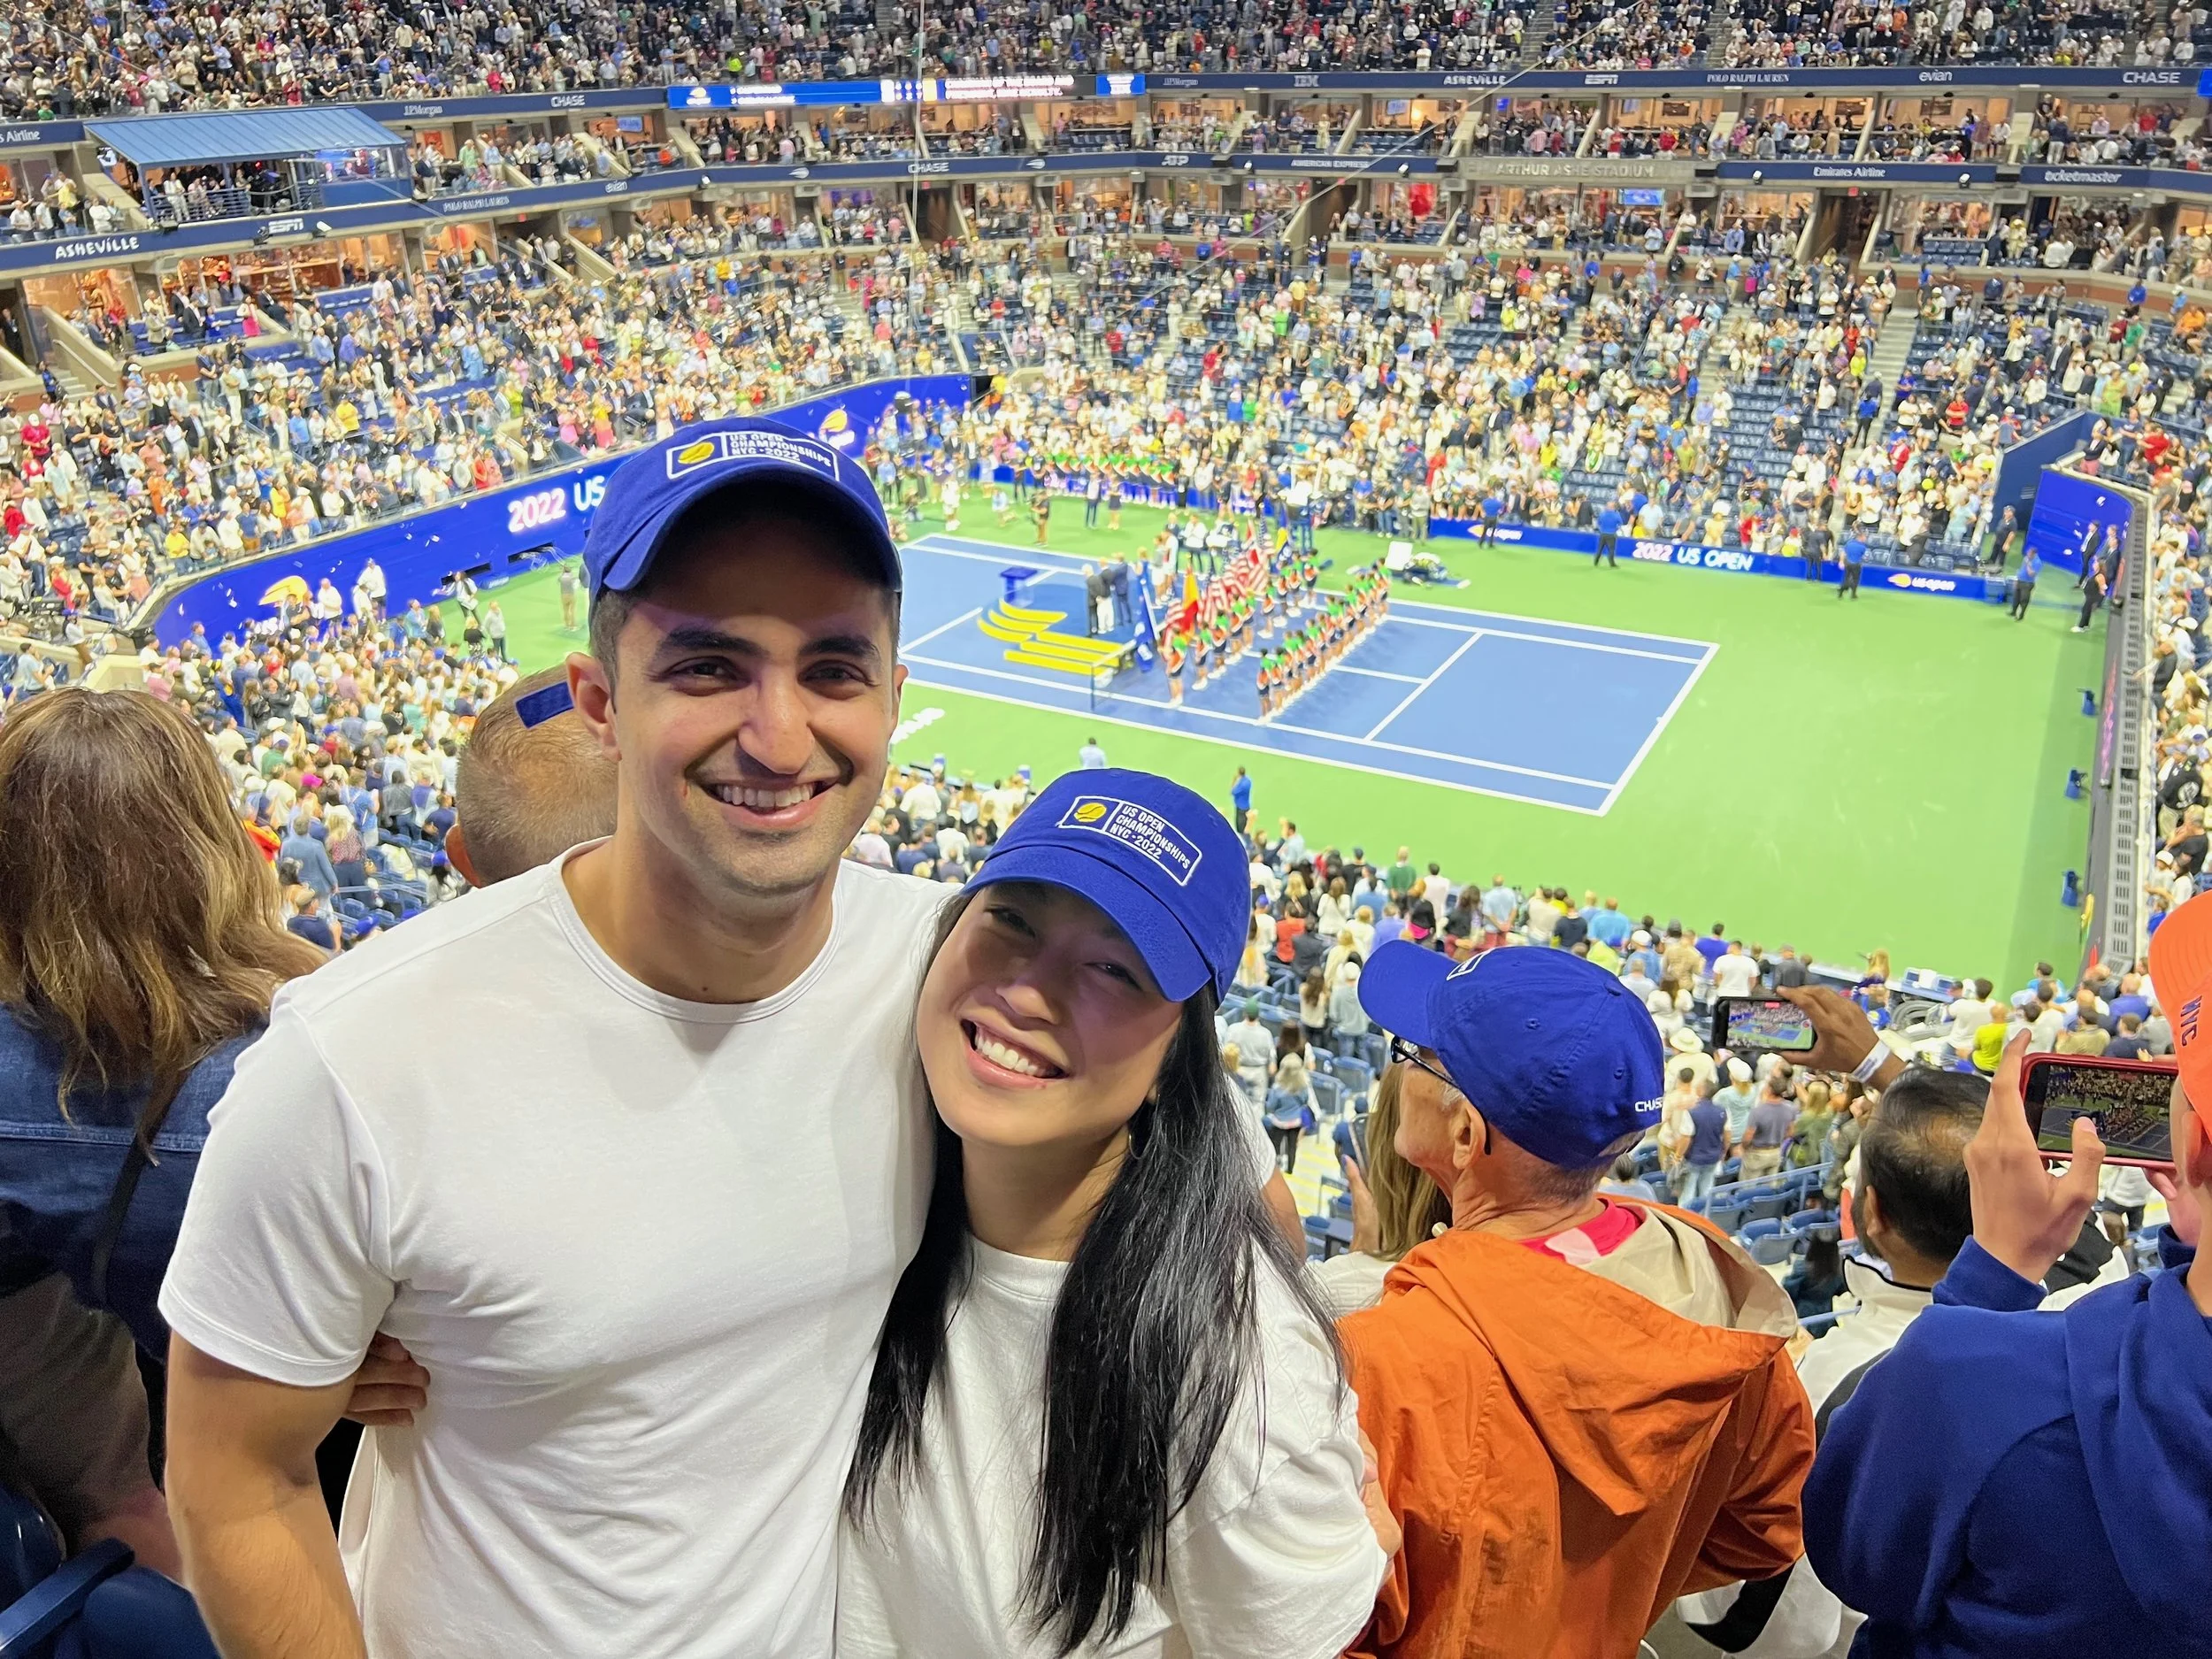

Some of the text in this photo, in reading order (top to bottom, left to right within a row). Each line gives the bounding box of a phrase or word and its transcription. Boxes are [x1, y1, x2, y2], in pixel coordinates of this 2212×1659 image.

[1294, 75, 1319, 88] IBM
[1585, 74, 1618, 85] ESPN
[1918, 69, 1952, 81] evian
[2123, 72, 2181, 83] CHASE
[550, 95, 586, 107] CHASE
[6, 129, 41, 142] Airline
[908, 162, 949, 173] CHASE
[1495, 163, 1655, 177] ARTHUR ASHE STADIUM
[1814, 166, 1886, 177] Emirates Airline
[268, 219, 303, 234] ESPN
[750, 434, 784, 442] OPEN
[730, 441, 832, 467] CHAMPIONSHIPS
[764, 448, 801, 462] 2022
[508, 475, 606, 533] 2022 US
[1632, 541, 1754, 572] 2022 US OPEN
[1122, 805, 1165, 833] US OPEN
[1110, 823, 1163, 860] NYC 2022
[1115, 814, 1191, 870] CHAMPIONSHIPS
[2180, 995, 2202, 1047] NYC
